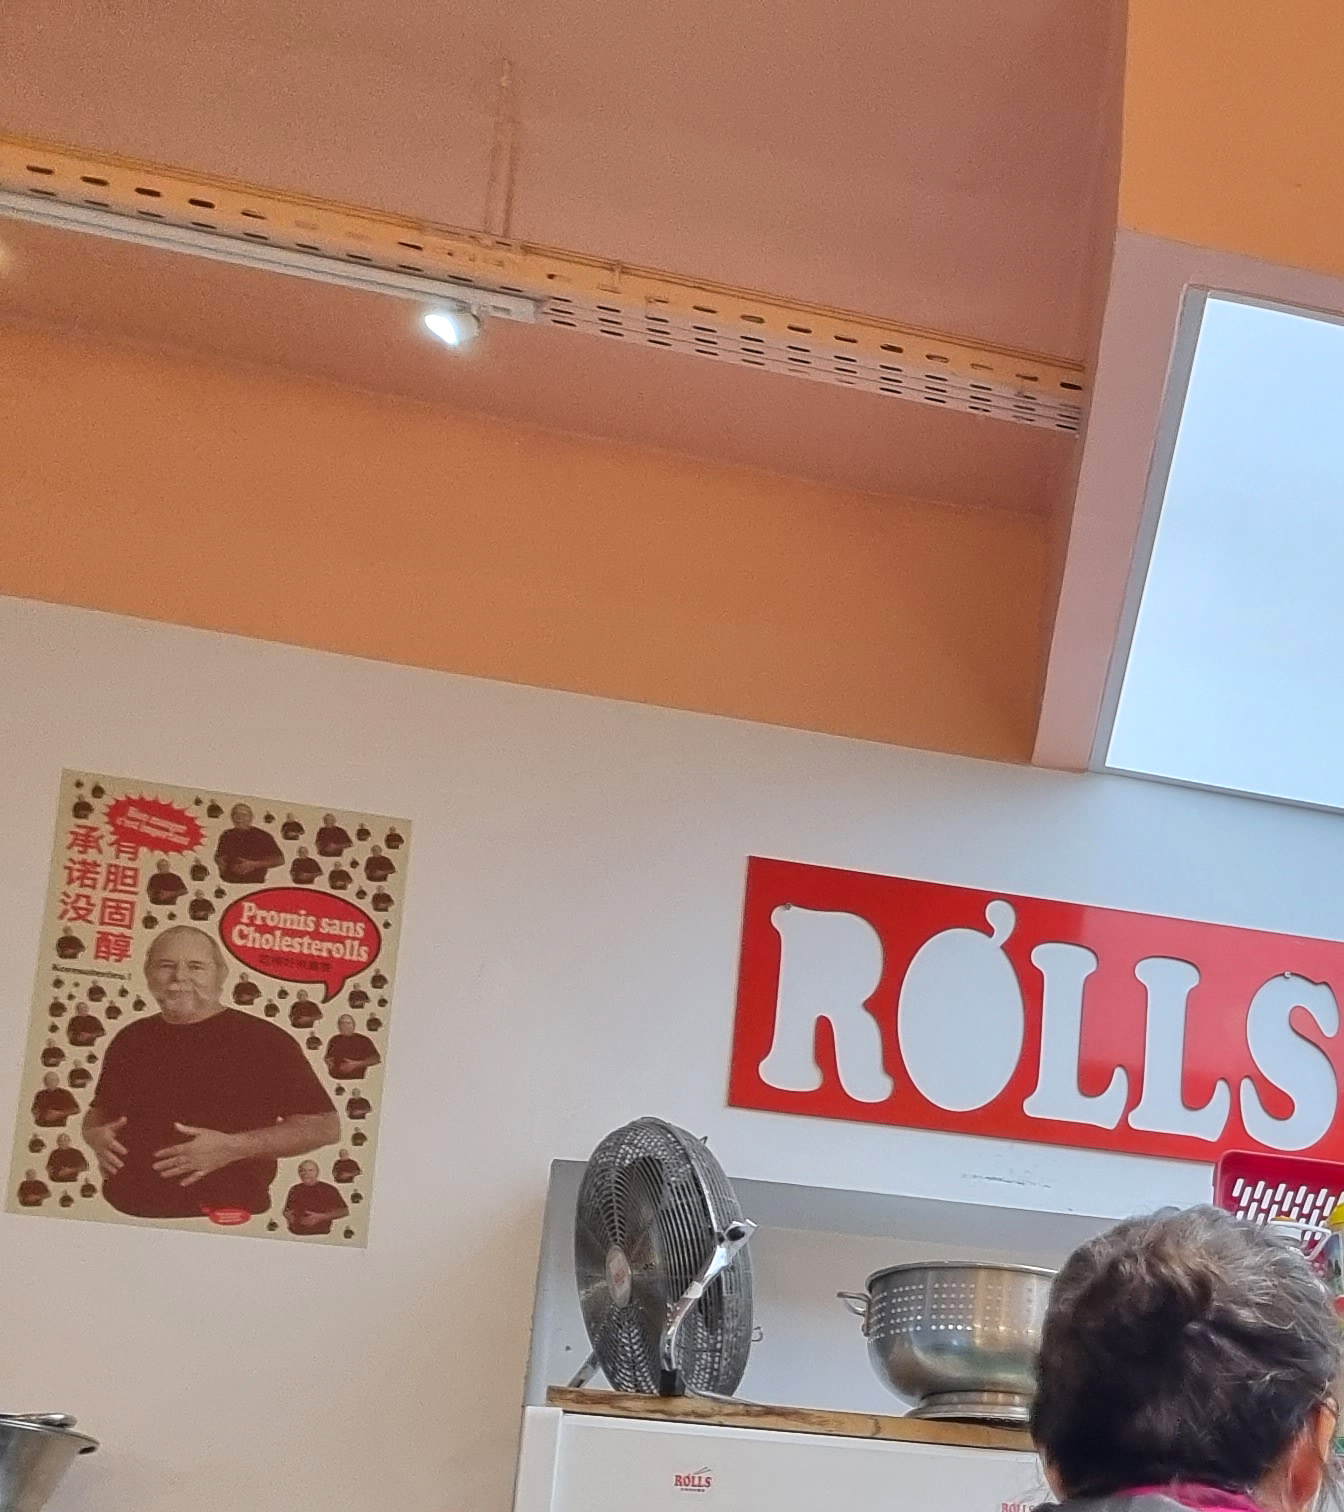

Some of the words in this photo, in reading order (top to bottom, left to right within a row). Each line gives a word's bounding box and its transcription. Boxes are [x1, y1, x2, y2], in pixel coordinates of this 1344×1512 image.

[241, 901, 316, 932] Promis
[320, 916, 366, 938] sans
[232, 924, 369, 962] Cholesterolls
